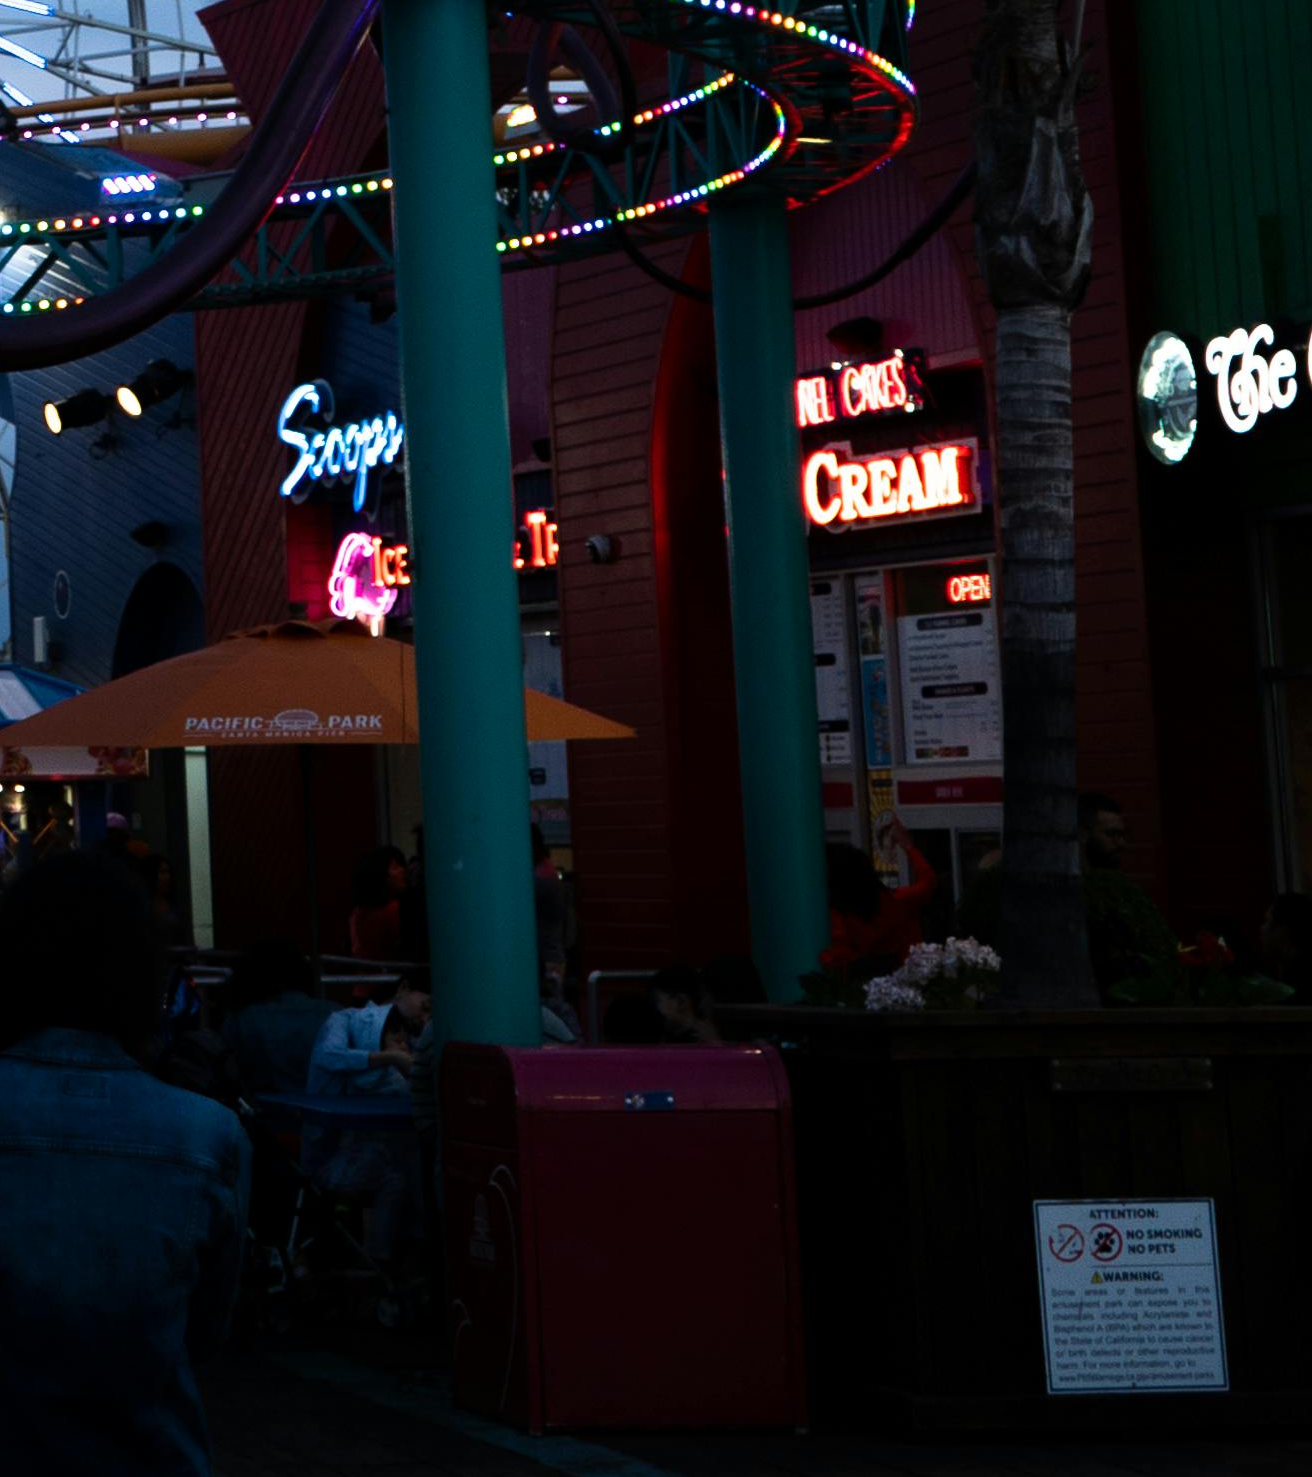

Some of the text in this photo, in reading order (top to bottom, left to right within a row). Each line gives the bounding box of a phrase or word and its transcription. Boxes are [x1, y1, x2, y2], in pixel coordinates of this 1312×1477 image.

[841, 357, 908, 417] CAKES
[1206, 324, 1297, 433] The
[804, 446, 964, 526] CREAM
[372, 536, 411, 587] ICE
[948, 574, 991, 602] OPEN
[185, 713, 383, 730] PACIFIC PARK
[1089, 1208, 1160, 1219] ATTENTION:
[1127, 1228, 1203, 1239] NO SMOKING
[1128, 1243, 1176, 1254] NO PETS
[1103, 1271, 1165, 1282] WARNING:
